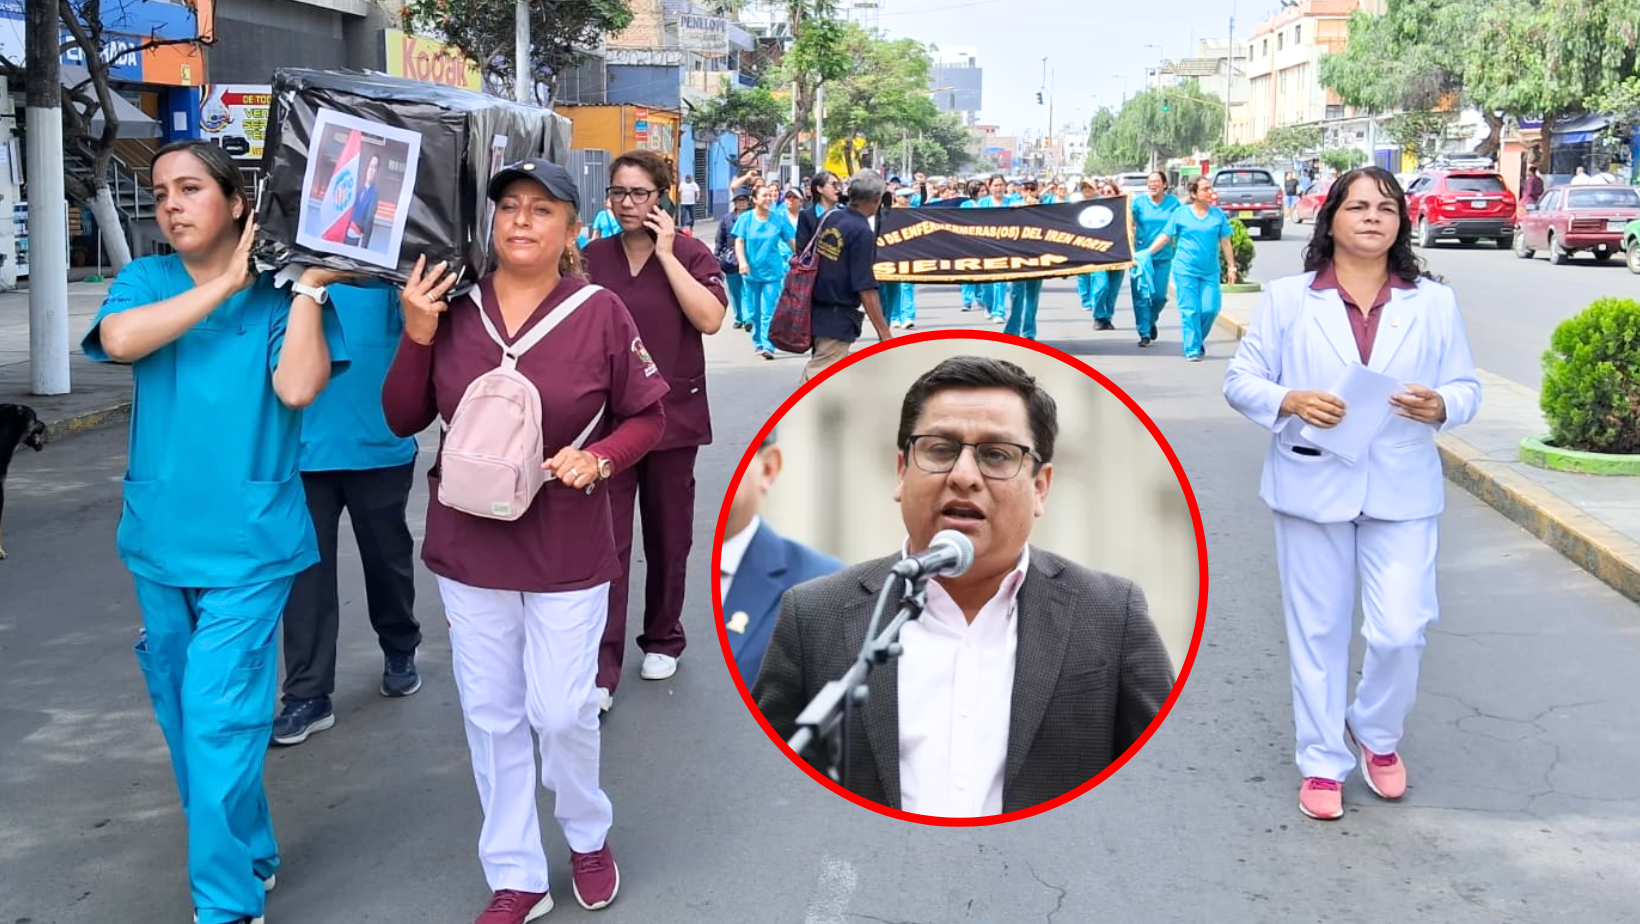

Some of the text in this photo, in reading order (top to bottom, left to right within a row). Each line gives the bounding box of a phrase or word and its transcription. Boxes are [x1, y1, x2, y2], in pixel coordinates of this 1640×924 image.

[884, 230, 903, 245] DE
[1020, 226, 1043, 240] DEL
[1044, 229, 1075, 245] IREN
[1072, 235, 1115, 252] NORTE
